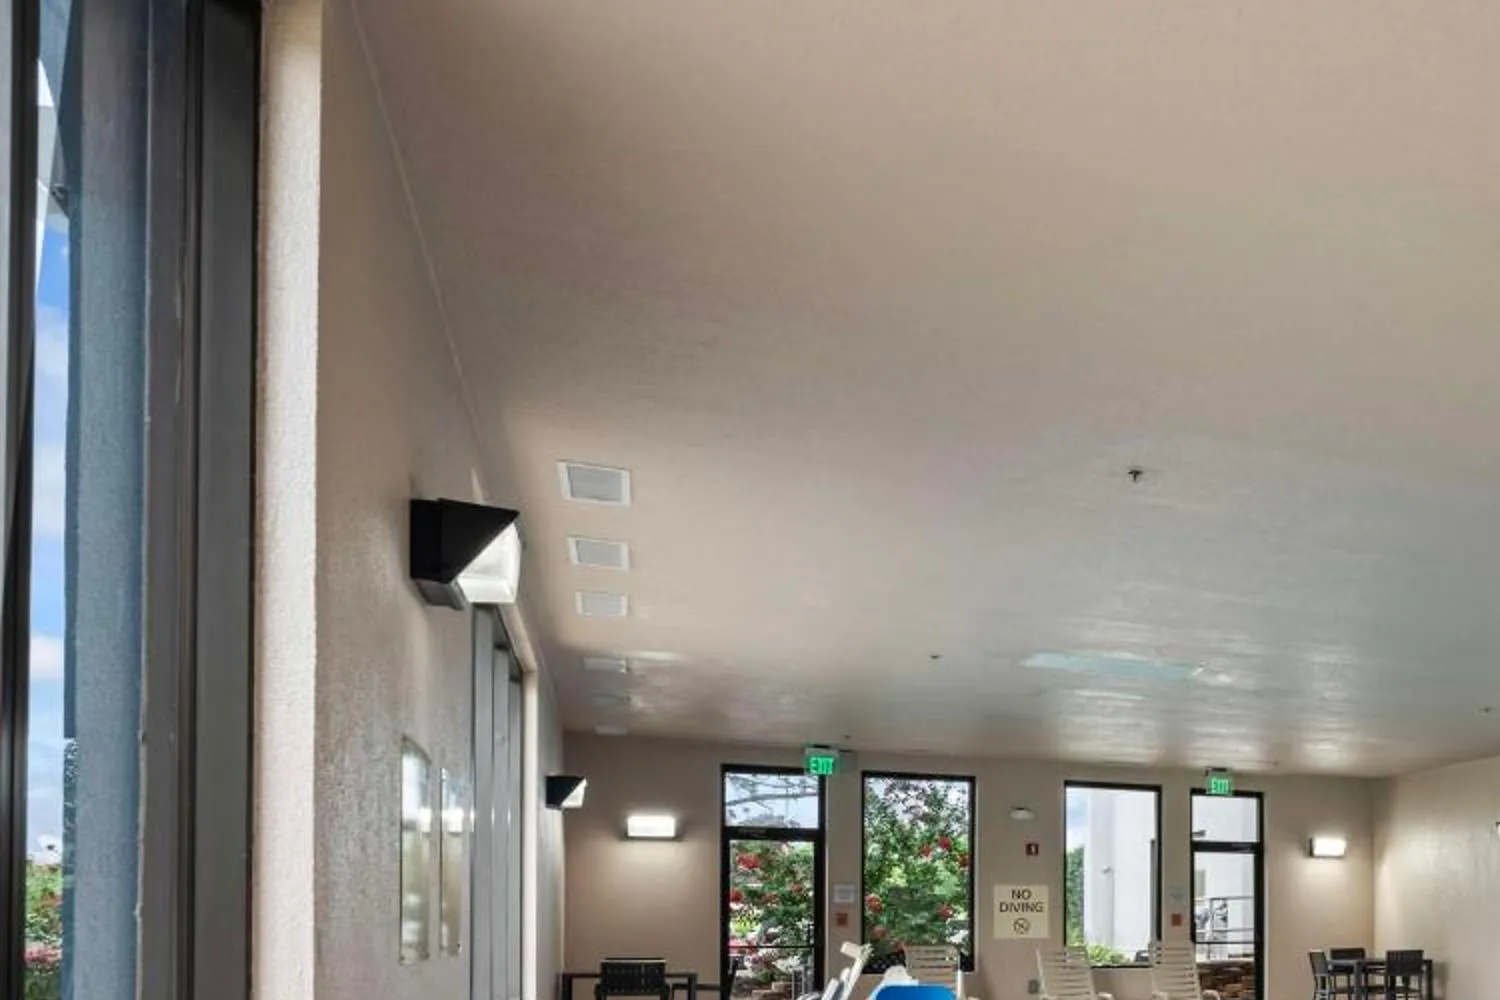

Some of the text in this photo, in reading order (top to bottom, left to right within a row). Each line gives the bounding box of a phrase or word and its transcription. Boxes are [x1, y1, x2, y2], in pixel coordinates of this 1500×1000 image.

[810, 756, 833, 774] EXIT
[1211, 776, 1229, 794] EXIT
[1011, 889, 1032, 900] NO
[999, 902, 1044, 912] DIVING
